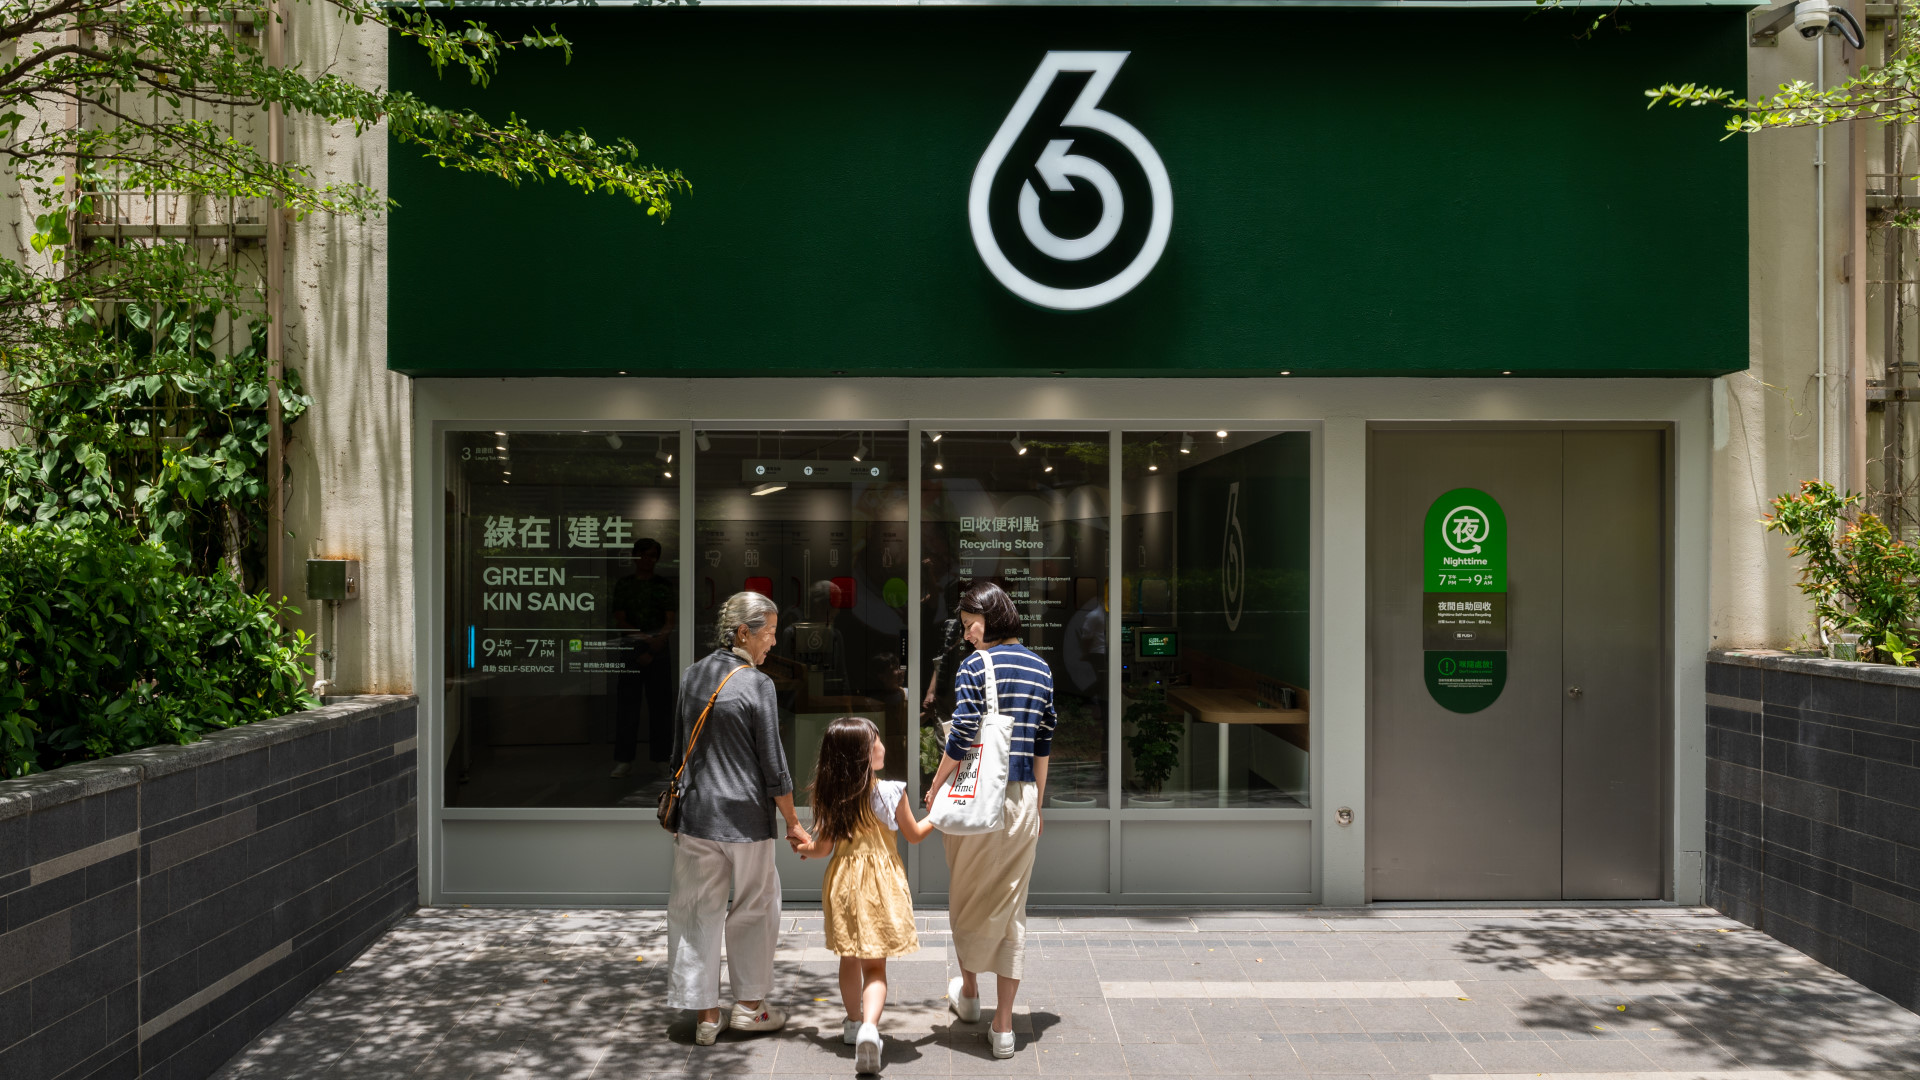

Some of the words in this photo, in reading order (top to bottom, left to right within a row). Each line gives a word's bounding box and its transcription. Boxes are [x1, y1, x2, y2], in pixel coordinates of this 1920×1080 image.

[461, 447, 471, 460] 3
[960, 516, 1040, 532] 回收便利點
[483, 515, 551, 549] 綠在
[567, 515, 635, 549] 建生
[960, 539, 1012, 551] Recycling
[1014, 539, 1044, 549] Store
[1443, 557, 1488, 567] Nighttime
[483, 566, 566, 586] GREEN
[1438, 574, 1446, 586] 7
[1474, 574, 1482, 586] 9
[483, 592, 522, 611] KIN
[527, 592, 595, 611] SANG
[1438, 601, 1492, 611] 夜間自助回收
[482, 638, 496, 657] 9
[526, 638, 540, 658] 7
[497, 638, 512, 647] 上午
[540, 639, 556, 648] 下午
[541, 650, 555, 658] PM
[482, 665, 497, 673] 自助
[957, 768, 978, 782] good
[954, 783, 973, 792] time
